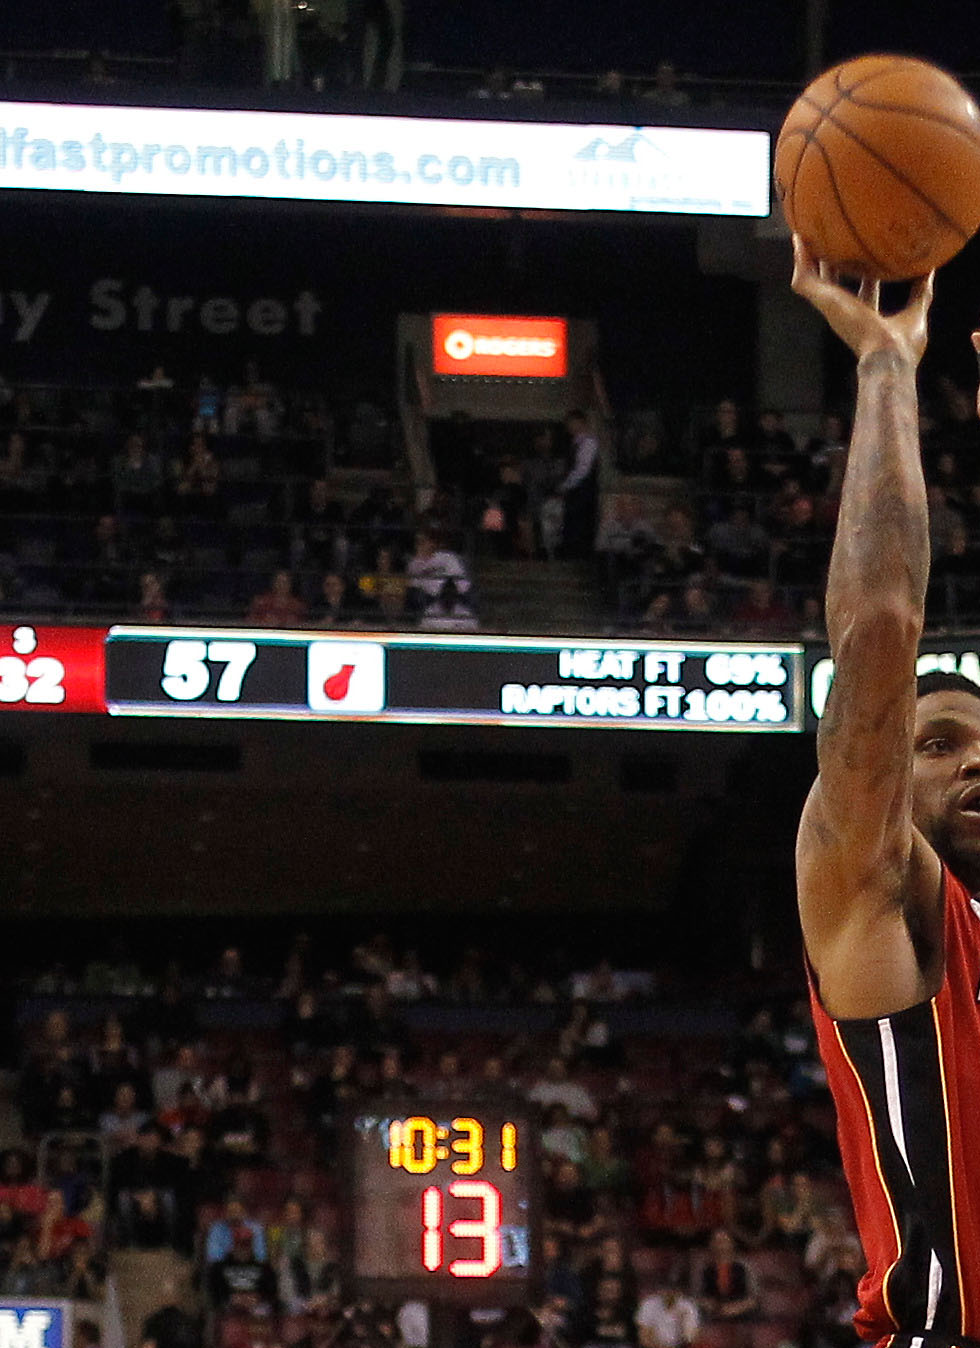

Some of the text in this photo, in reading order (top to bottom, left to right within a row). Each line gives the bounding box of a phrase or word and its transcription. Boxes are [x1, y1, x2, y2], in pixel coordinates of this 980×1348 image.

[0, 278, 324, 342] y Street
[161, 640, 257, 701] 57
[559, 650, 636, 679] HEAT
[645, 652, 684, 683] FT
[502, 684, 788, 722] RAPTORS FT 100%
[390, 1117, 517, 1174] 10:31
[422, 1180, 502, 1277] 13
